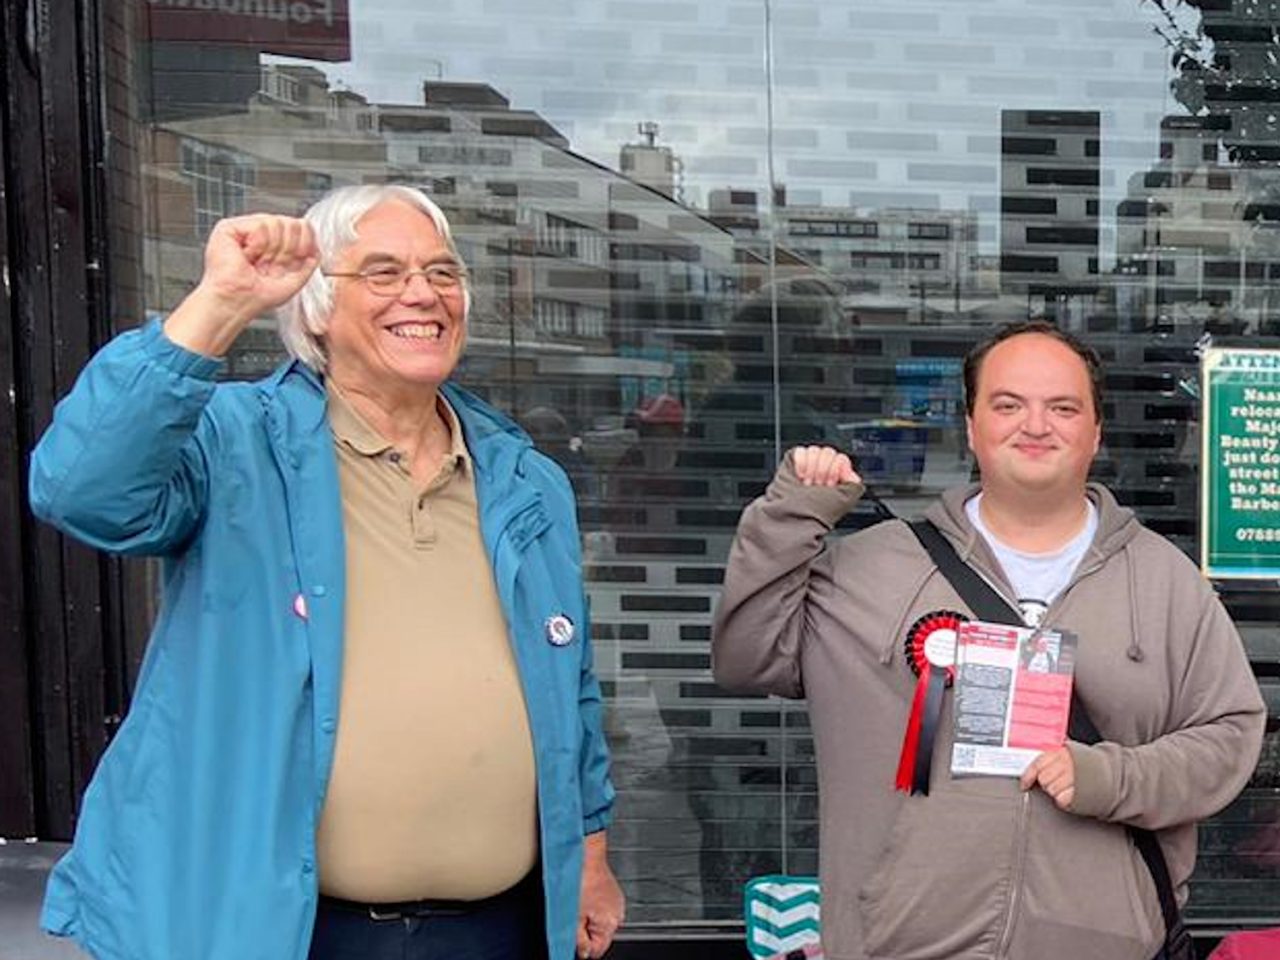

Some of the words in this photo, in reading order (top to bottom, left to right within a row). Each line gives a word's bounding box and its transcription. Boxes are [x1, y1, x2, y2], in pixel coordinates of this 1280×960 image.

[1220, 434, 1278, 452] Beauty
[1223, 450, 1257, 466] just
[1229, 467, 1279, 480] street
[1229, 482, 1257, 495] the
